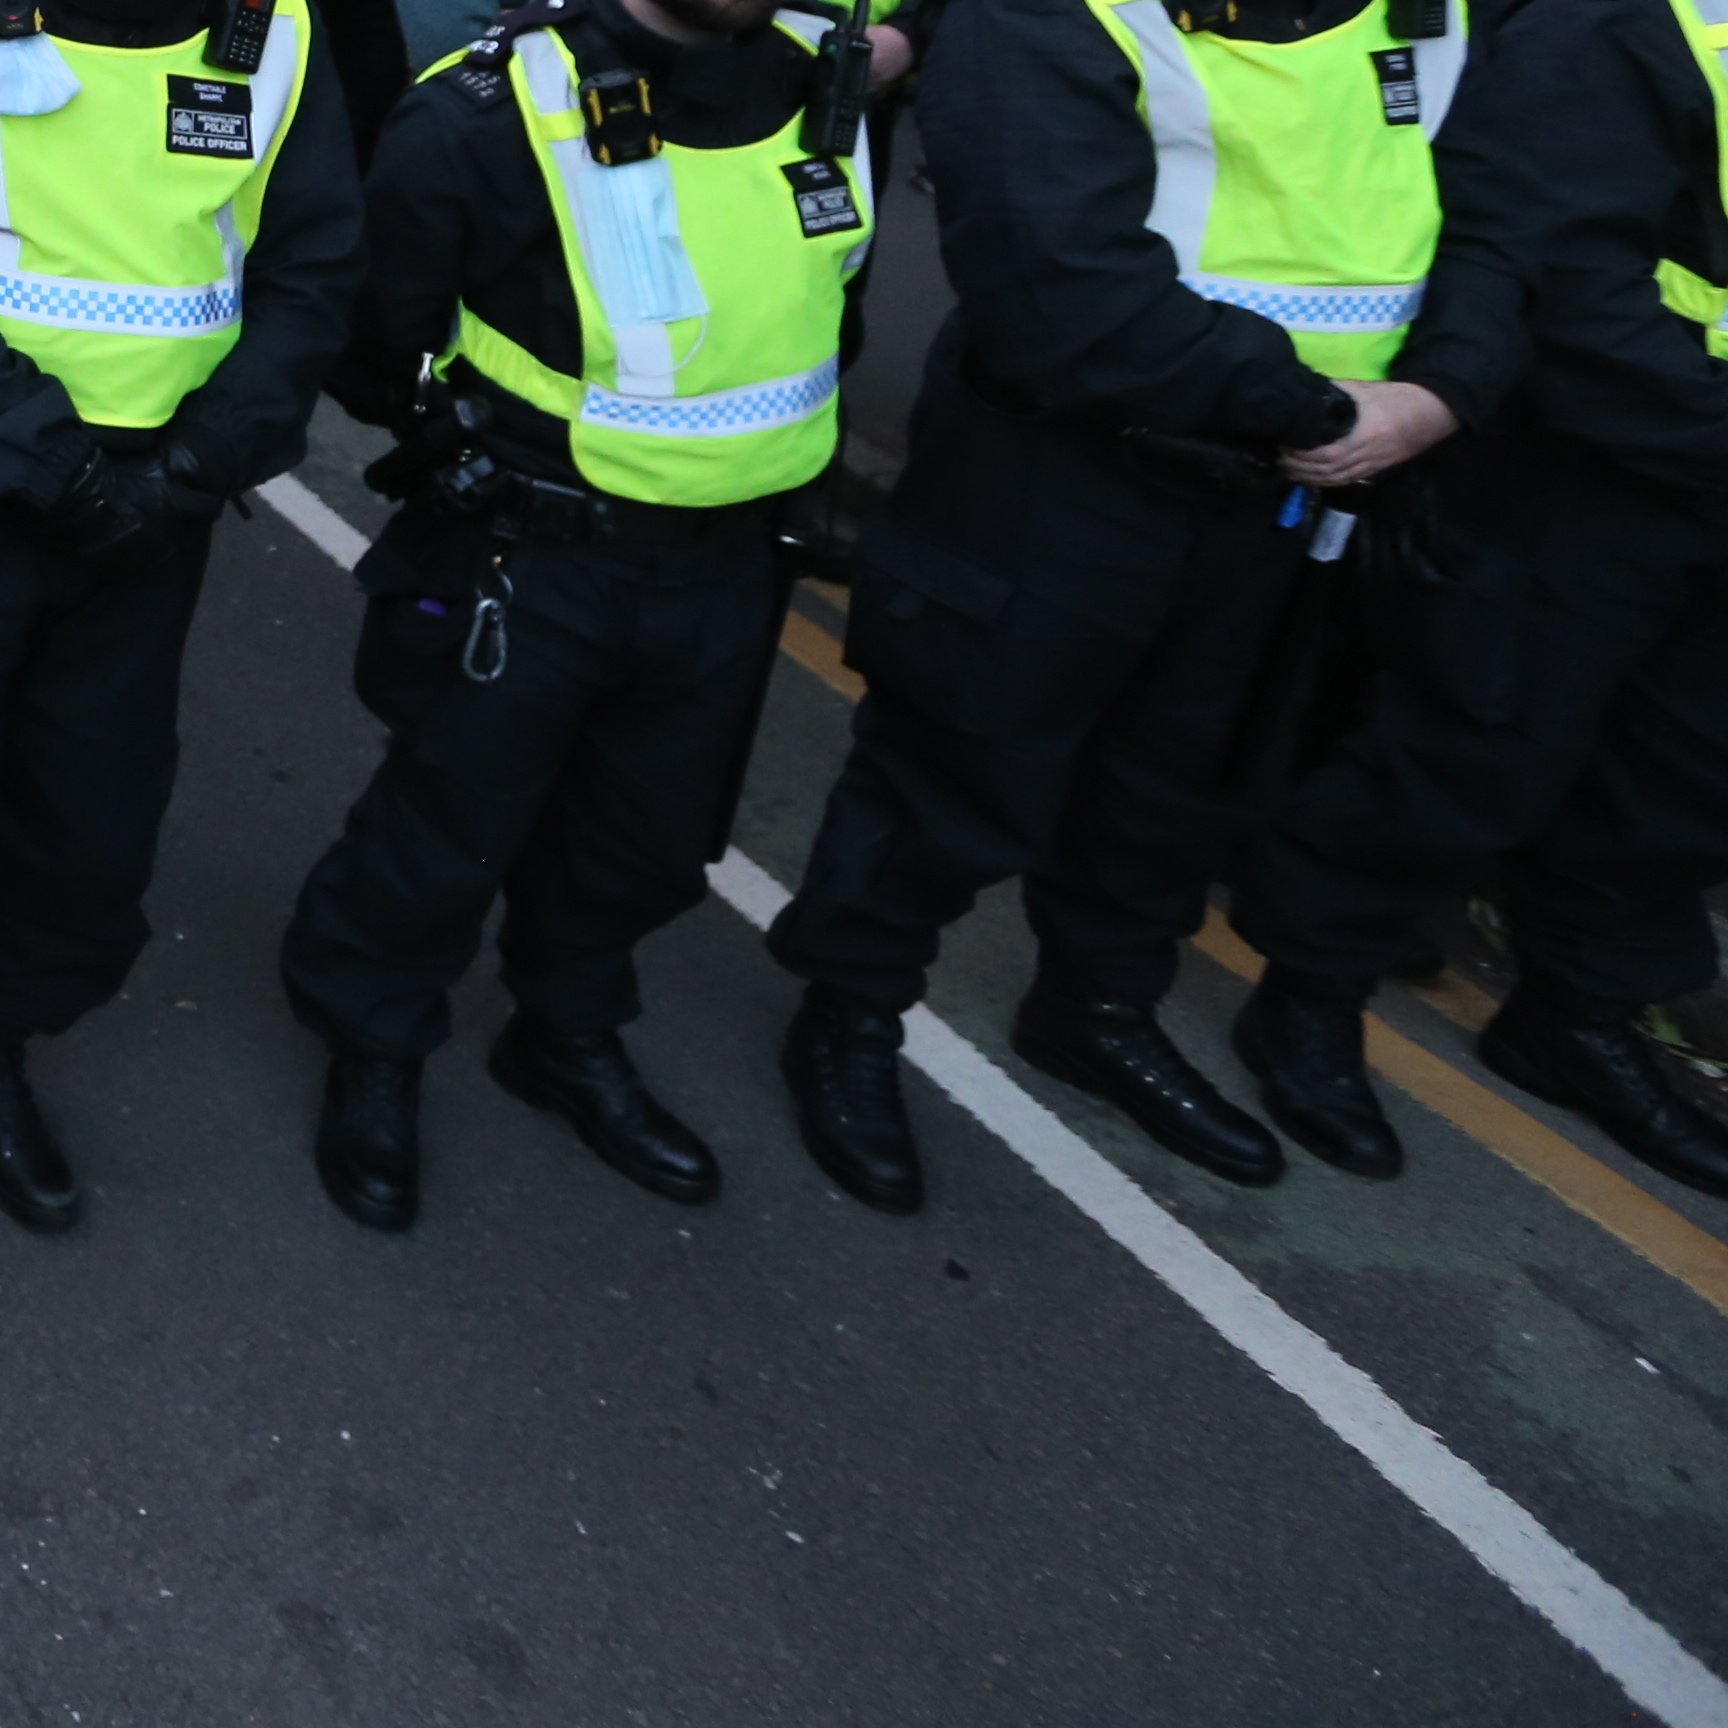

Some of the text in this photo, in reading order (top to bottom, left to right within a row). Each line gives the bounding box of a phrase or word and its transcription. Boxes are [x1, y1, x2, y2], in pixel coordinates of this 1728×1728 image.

[203, 121, 237, 135] POLICE
[171, 134, 248, 152] POLICE OFFICER
